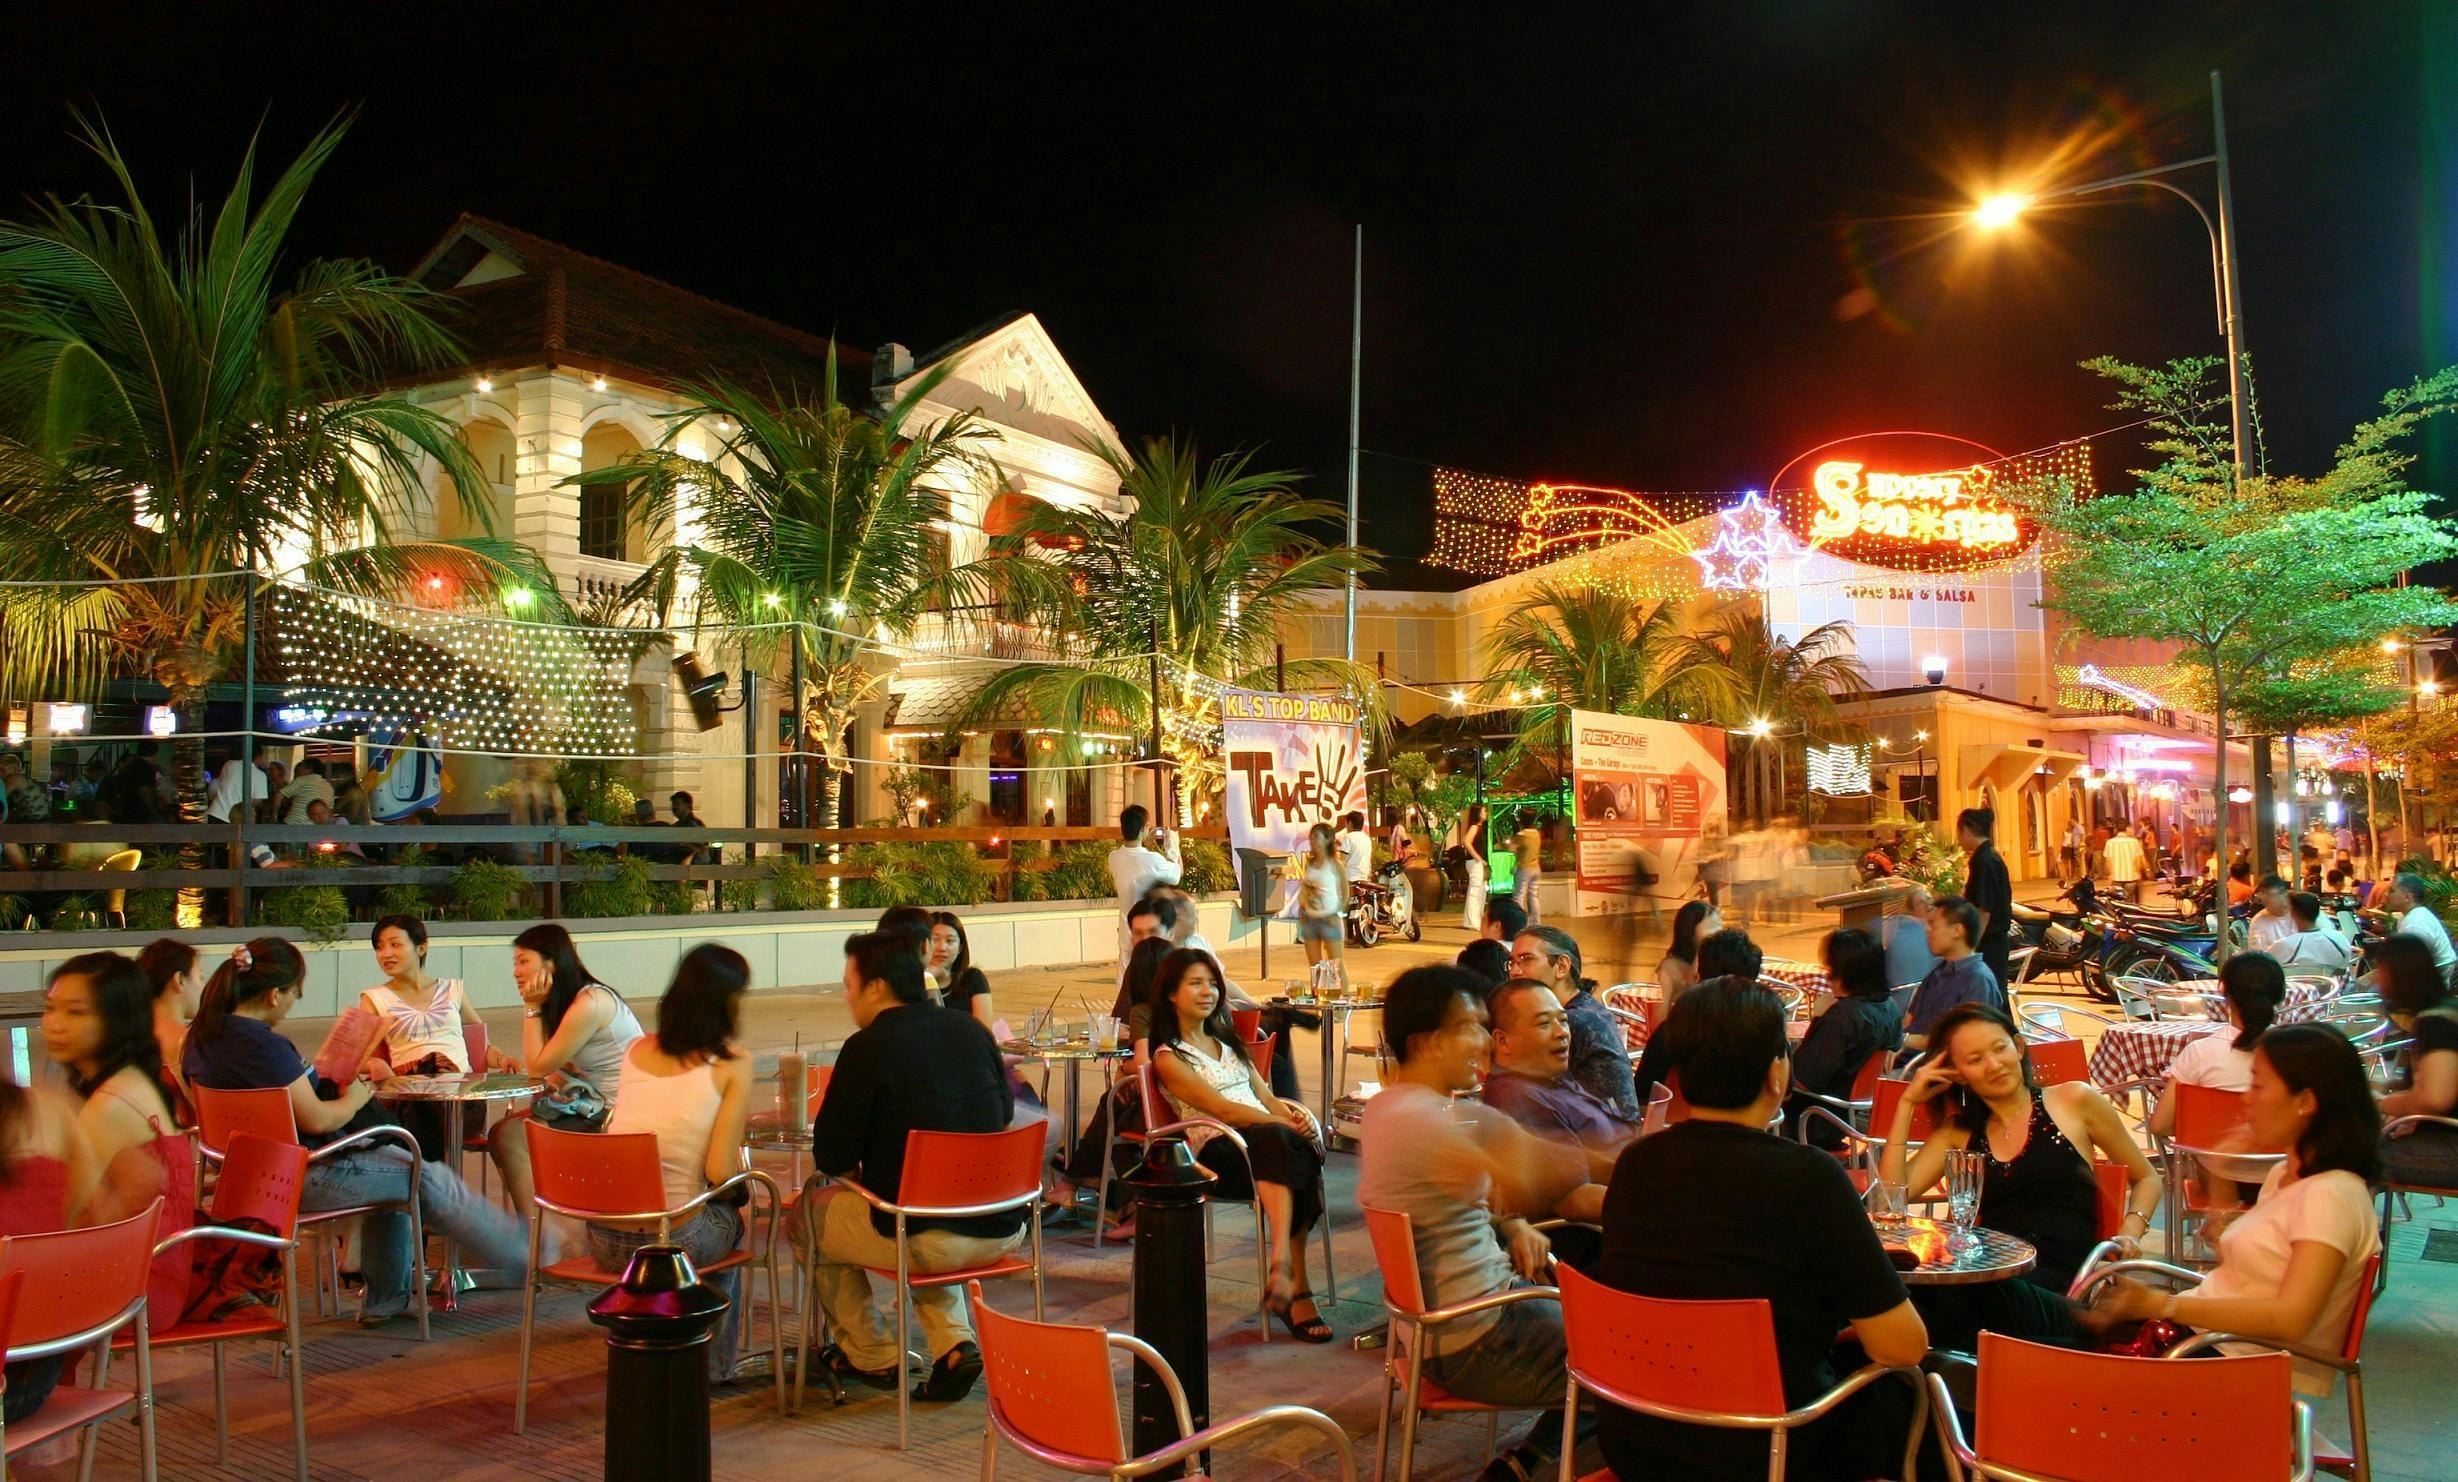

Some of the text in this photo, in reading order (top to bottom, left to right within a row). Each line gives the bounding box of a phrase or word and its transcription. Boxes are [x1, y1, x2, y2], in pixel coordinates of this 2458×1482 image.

[1844, 586, 1976, 602] TAPAS BAR & SALSA
[1225, 694, 1354, 724] KL'S TOP BAND
[1229, 751, 1317, 828] TAKE
